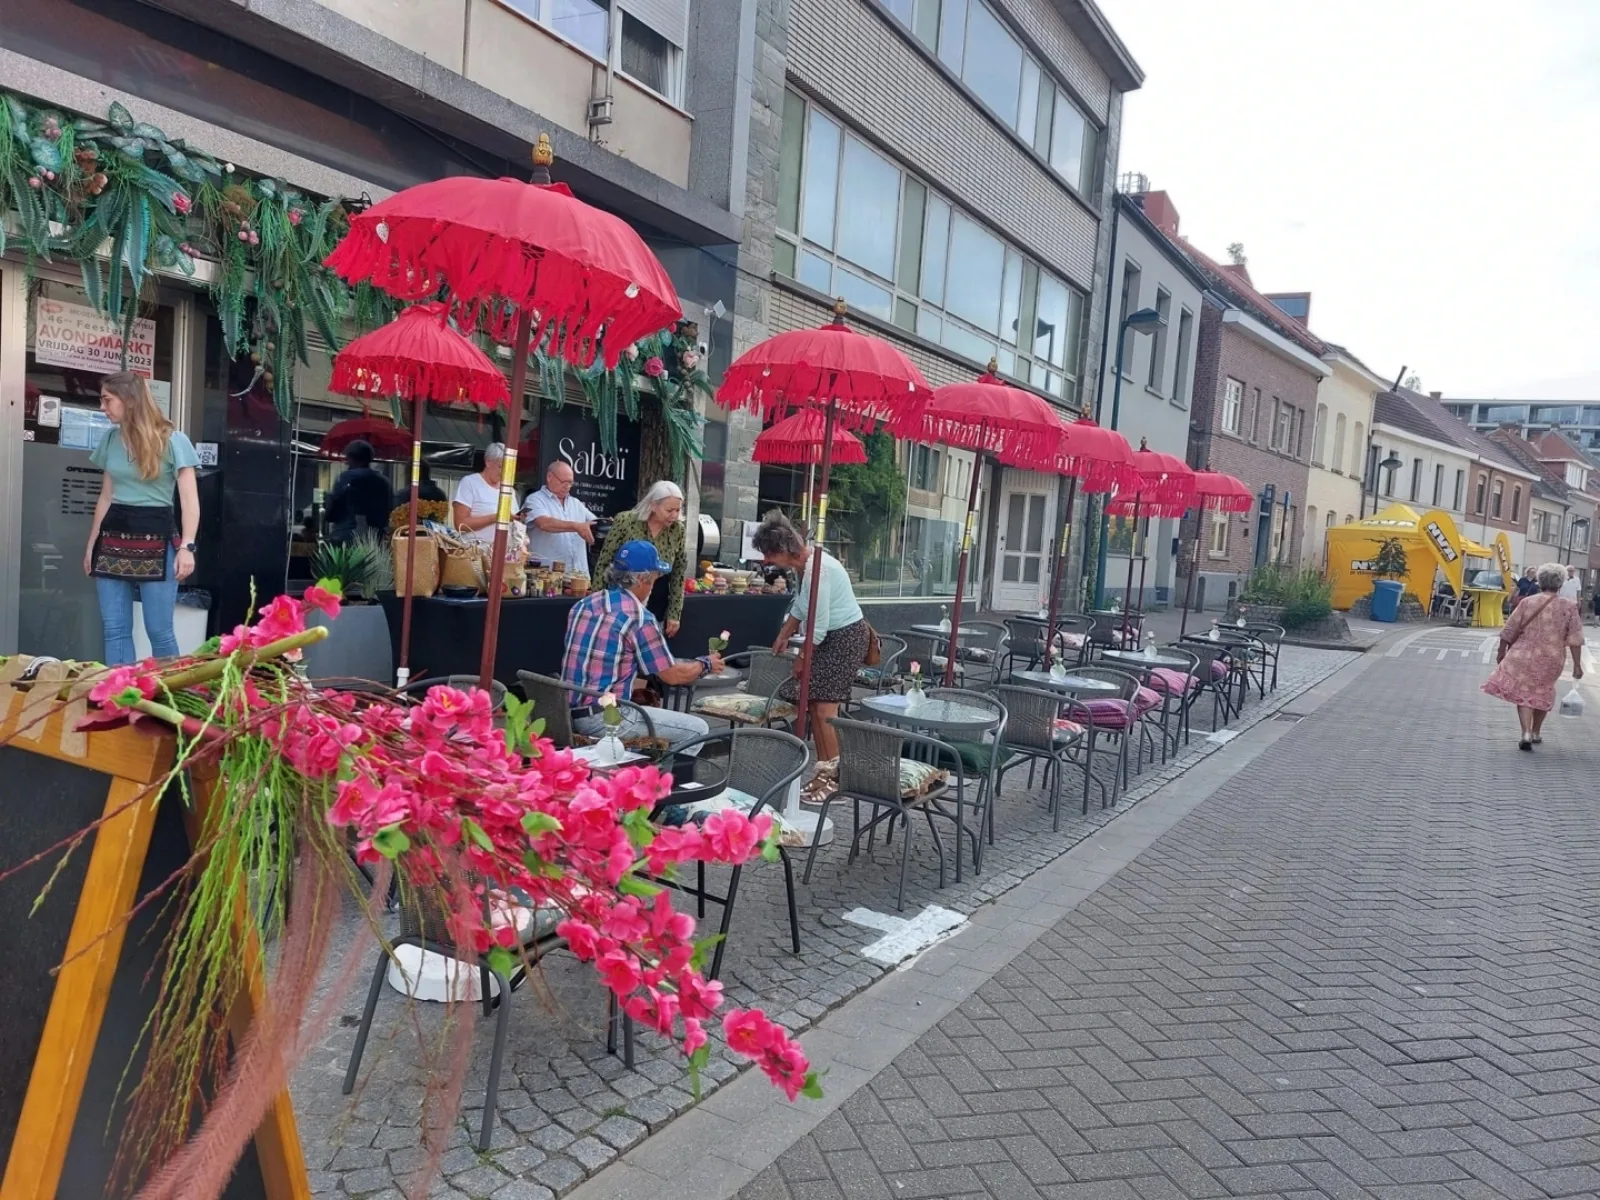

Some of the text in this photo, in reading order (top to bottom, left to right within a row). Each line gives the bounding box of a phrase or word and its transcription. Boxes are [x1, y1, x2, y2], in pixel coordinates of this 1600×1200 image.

[38, 339, 84, 354] VRIJDAG
[88, 347, 100, 357] 30
[103, 350, 125, 361] JUN
[129, 355, 152, 366] 2023
[40, 323, 153, 355] AVONDMARKT
[559, 437, 629, 480] Sabaï
